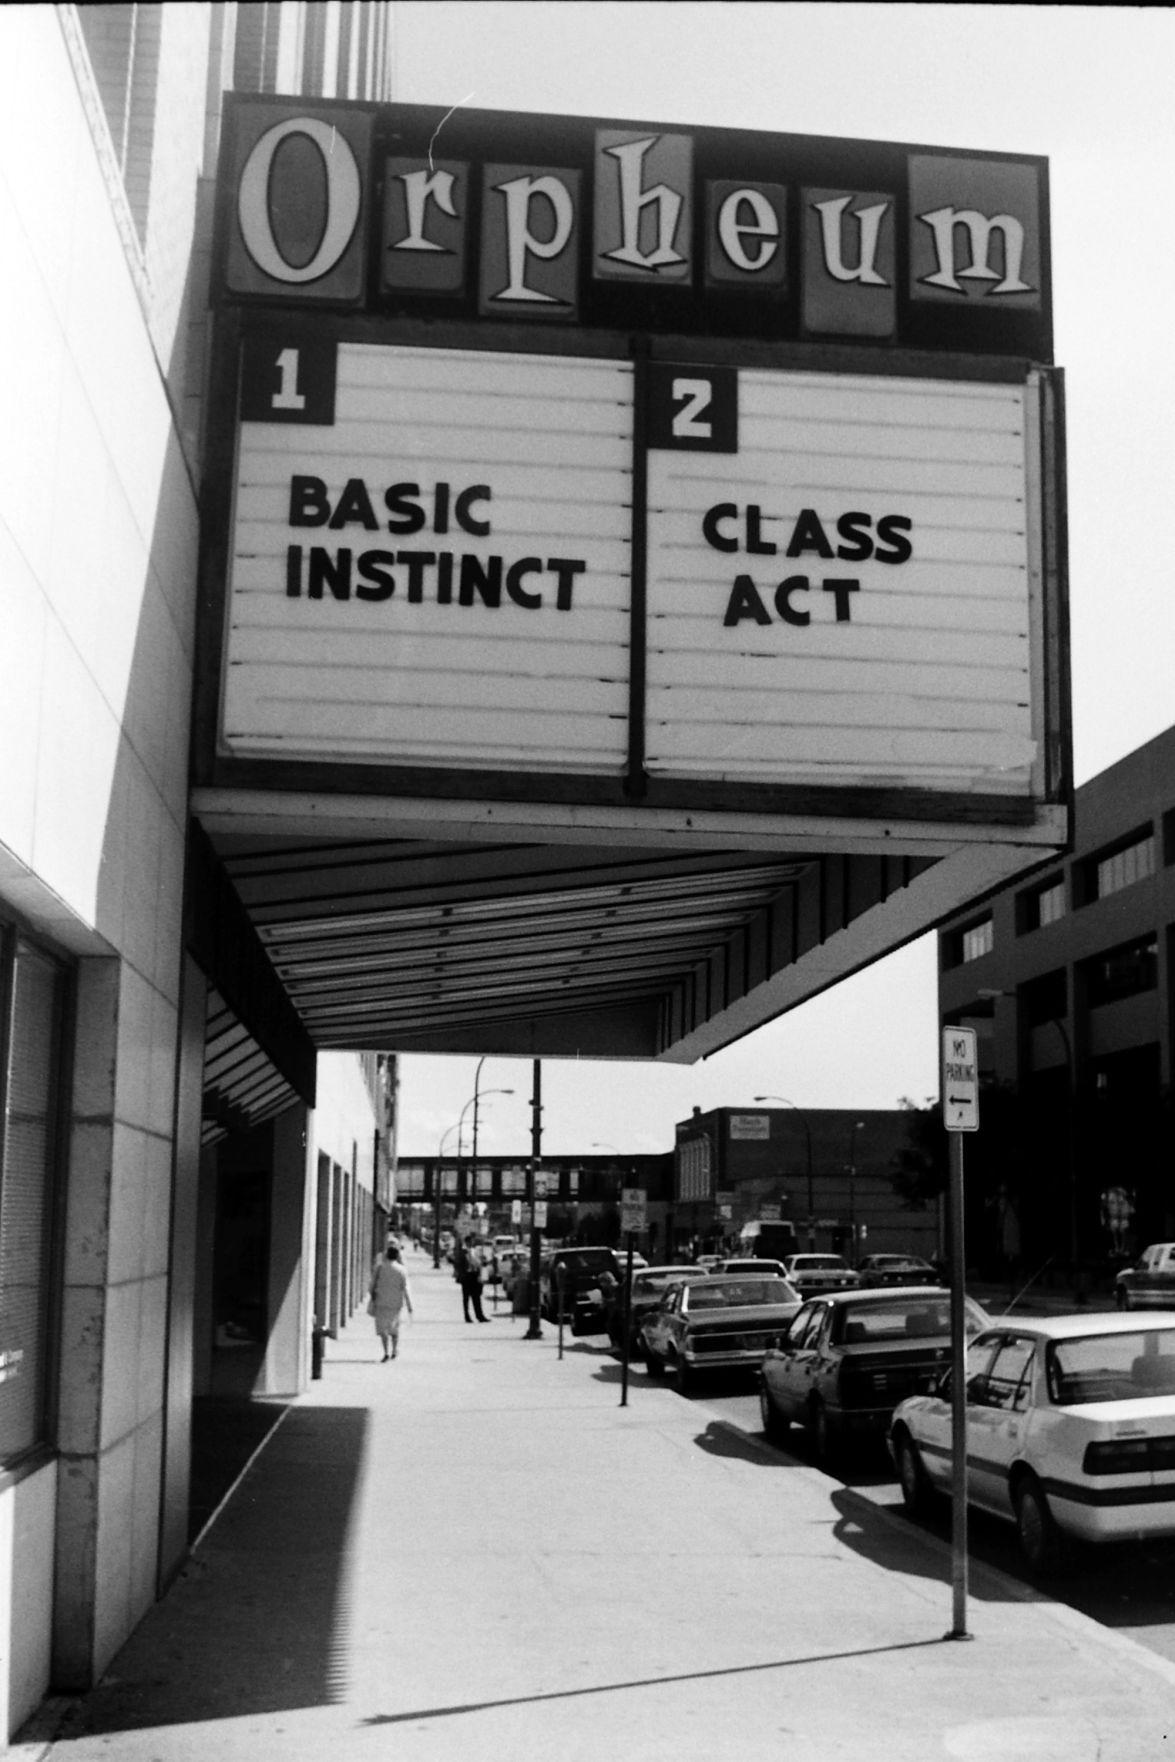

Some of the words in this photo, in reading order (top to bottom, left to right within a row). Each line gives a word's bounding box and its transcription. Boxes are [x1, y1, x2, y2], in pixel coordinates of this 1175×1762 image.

[237, 116, 1038, 304] Orpheum
[272, 349, 305, 409] 1
[672, 378, 712, 438] 2
[288, 474, 492, 538] BASIC
[702, 502, 913, 566] CLASS
[285, 544, 587, 612] INSTINCT
[723, 574, 861, 628] ACT
[953, 1039, 966, 1058] NO
